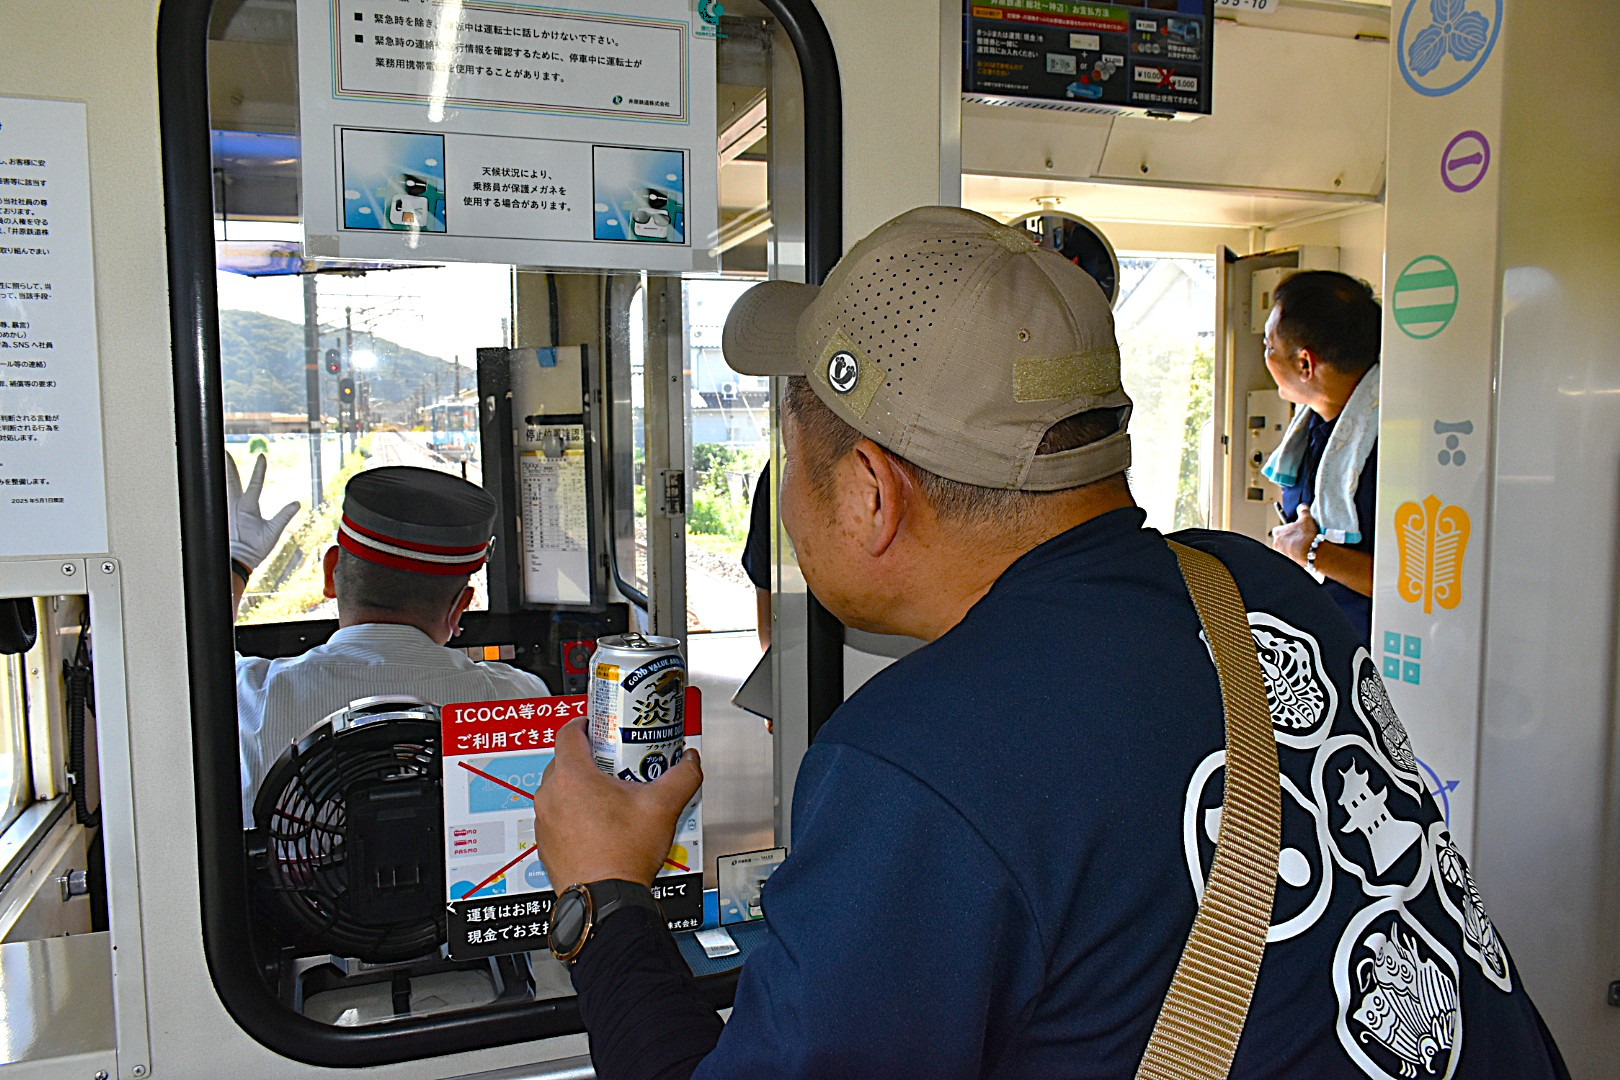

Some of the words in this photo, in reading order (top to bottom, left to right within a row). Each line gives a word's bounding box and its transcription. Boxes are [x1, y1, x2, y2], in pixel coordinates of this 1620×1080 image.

[374, 13, 620, 47] 緊急時を除き、転中は運転士に話しかけないで下さい。
[1137, 70, 1162, 79] ¥10,00
[482, 166, 553, 180] 天候状況により、
[472, 182, 567, 196] 乗務員が保護メガネを
[463, 196, 571, 212] 使用する場合があります。
[648, 657, 669, 673] VALUE
[455, 700, 586, 724] ICOCA等の全て
[457, 727, 555, 749] ご利用できま
[631, 728, 673, 740] PLATINUM
[454, 847, 478, 855] PASMO
[466, 900, 552, 922] 運賃はお降り
